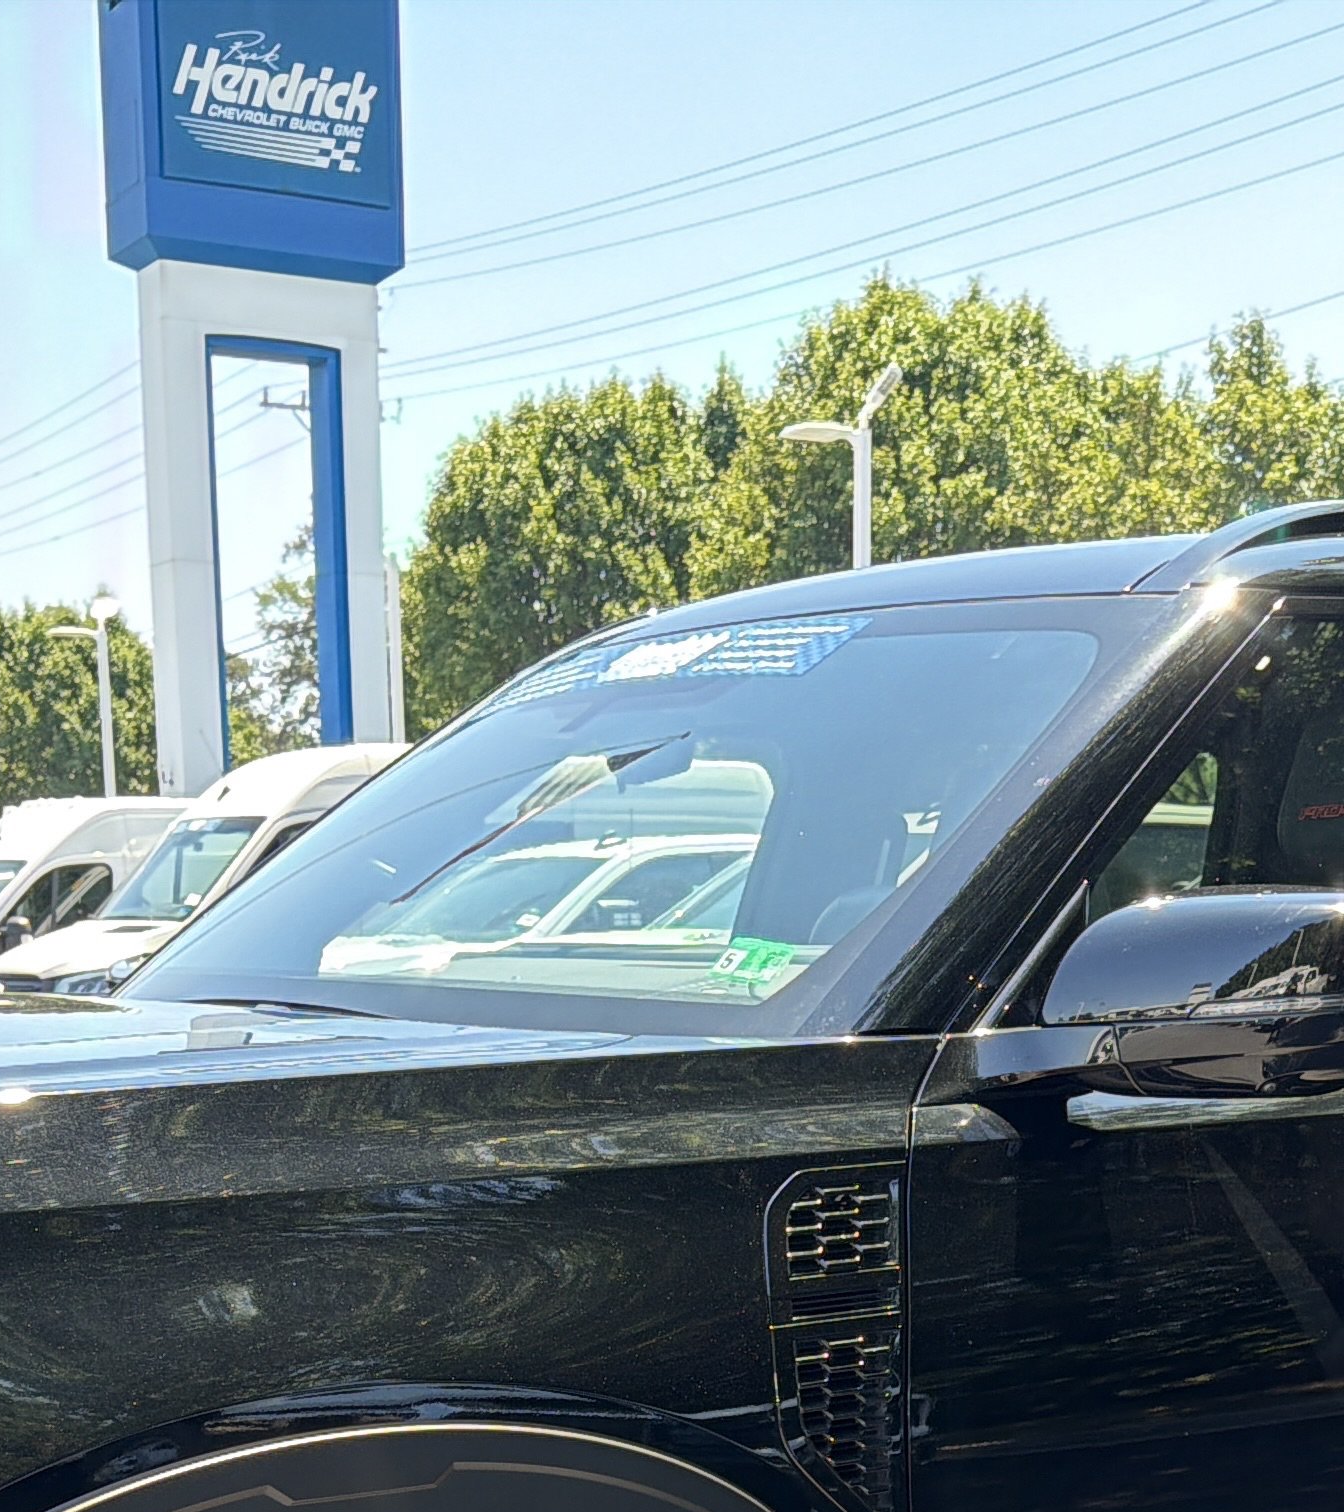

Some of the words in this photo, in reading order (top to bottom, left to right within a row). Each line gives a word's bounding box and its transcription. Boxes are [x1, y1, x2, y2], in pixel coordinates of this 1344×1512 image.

[172, 43, 378, 124] Hendrick
[207, 103, 288, 128] CHEVROLET
[288, 116, 331, 135] BUICK
[332, 123, 365, 140] GMC
